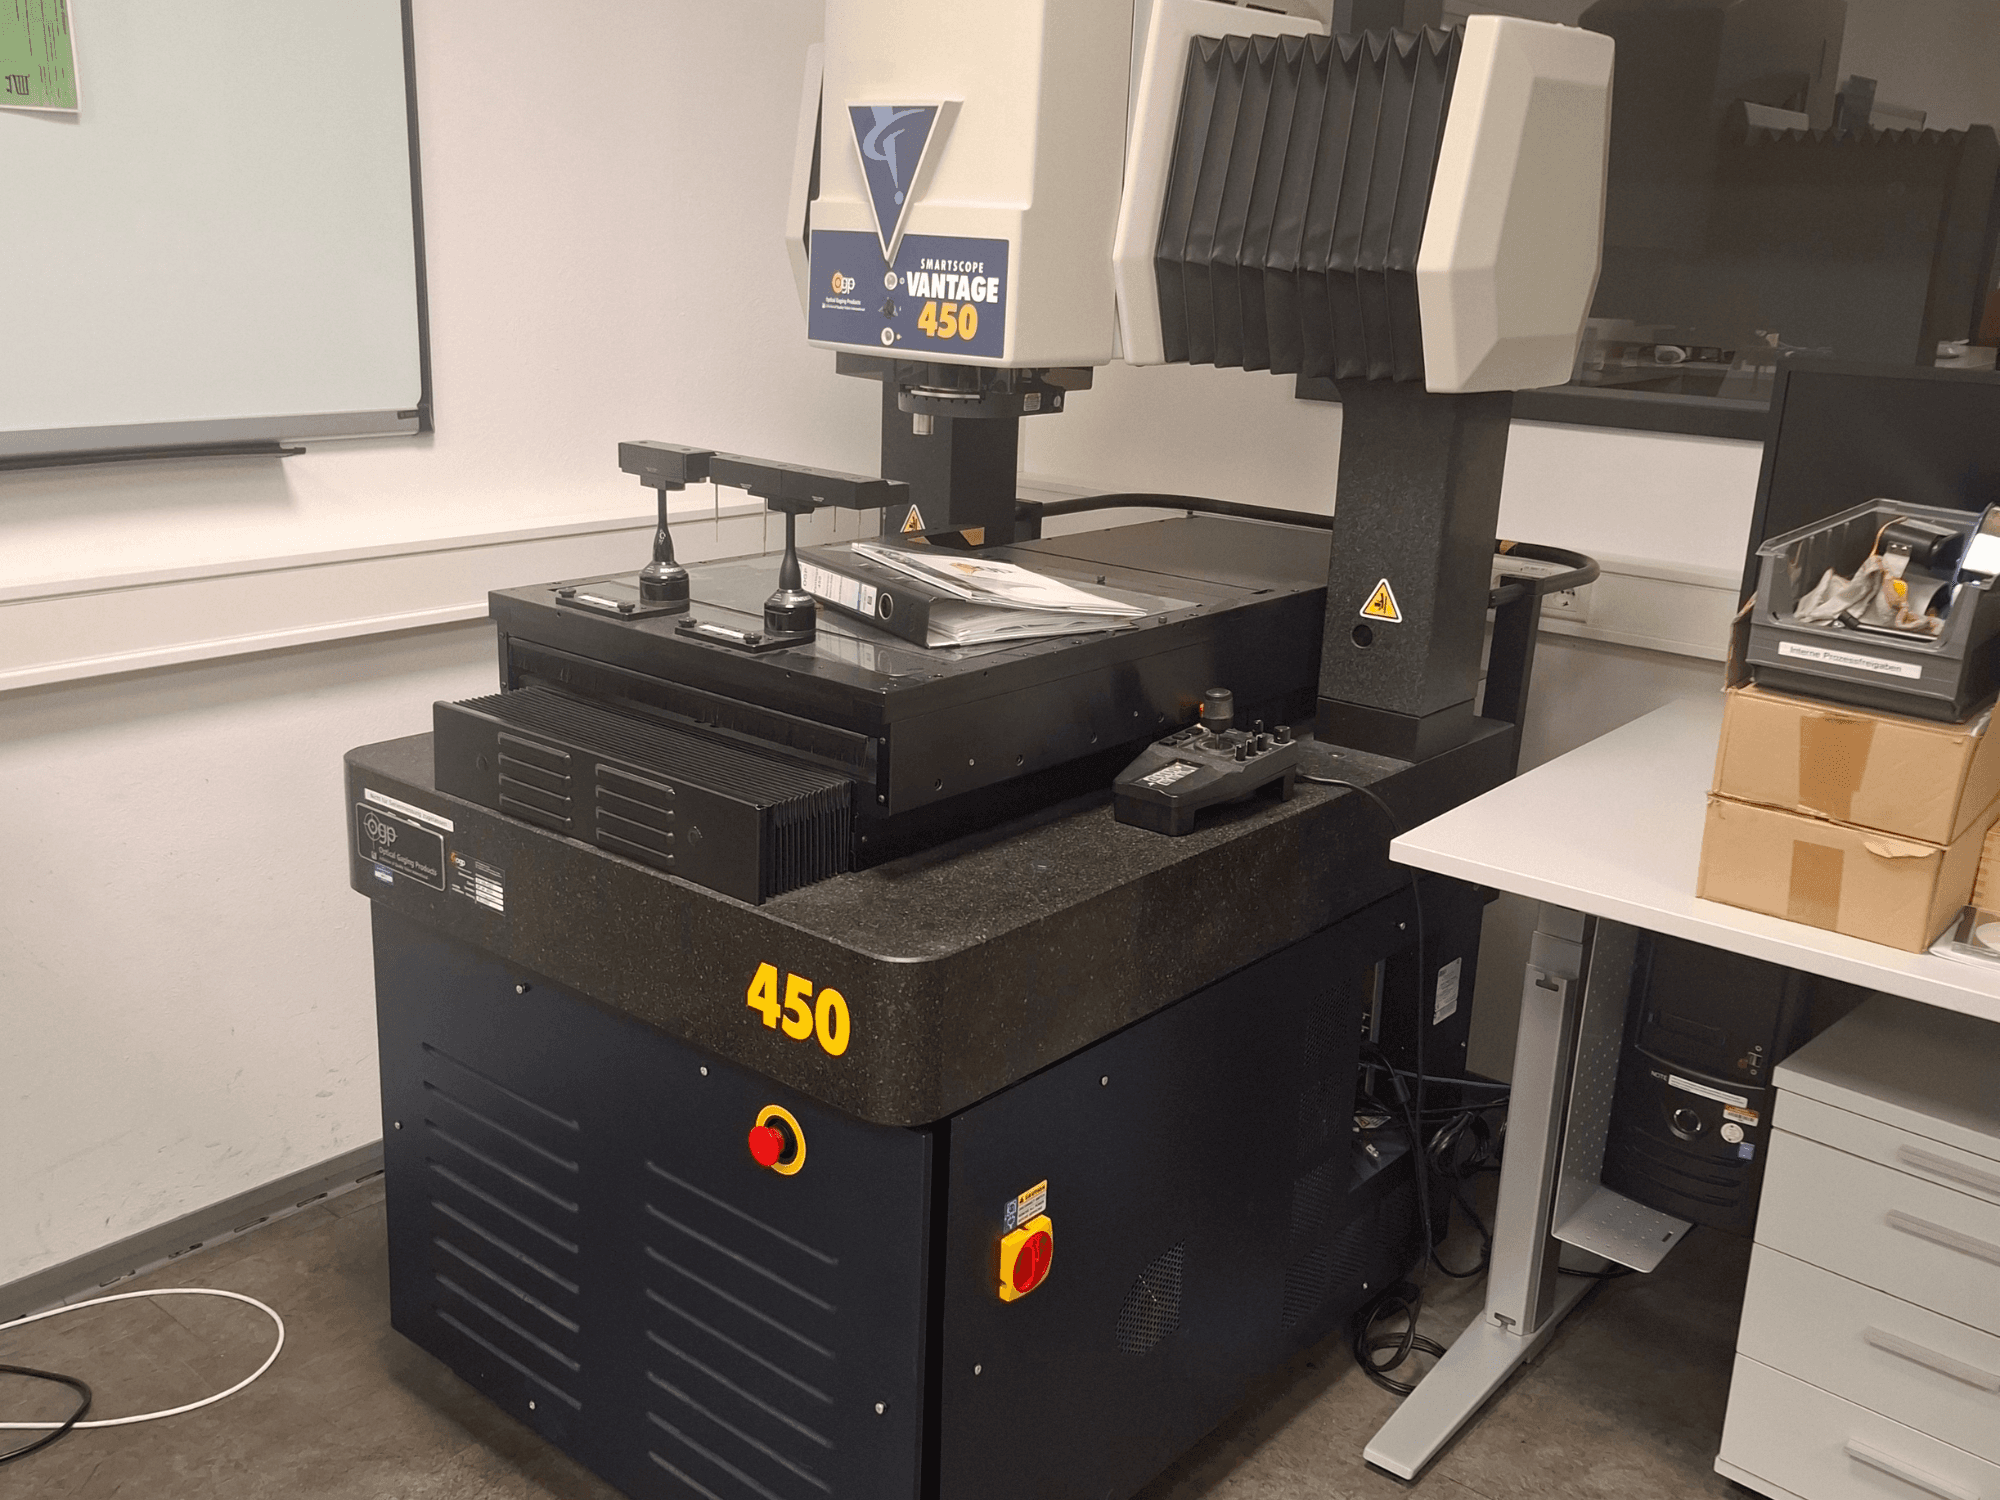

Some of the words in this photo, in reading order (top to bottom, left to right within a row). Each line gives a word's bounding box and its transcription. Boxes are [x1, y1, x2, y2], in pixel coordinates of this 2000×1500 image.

[920, 258, 984, 274] SMARTSCOPE
[906, 271, 1000, 303] VANTAGE
[917, 301, 979, 341] 450
[1790, 646, 1821, 659] Interne
[1823, 652, 1902, 672] Prozessfreigaben
[378, 846, 396, 859] Optical
[415, 861, 437, 876] Products
[747, 961, 851, 1056] 450
